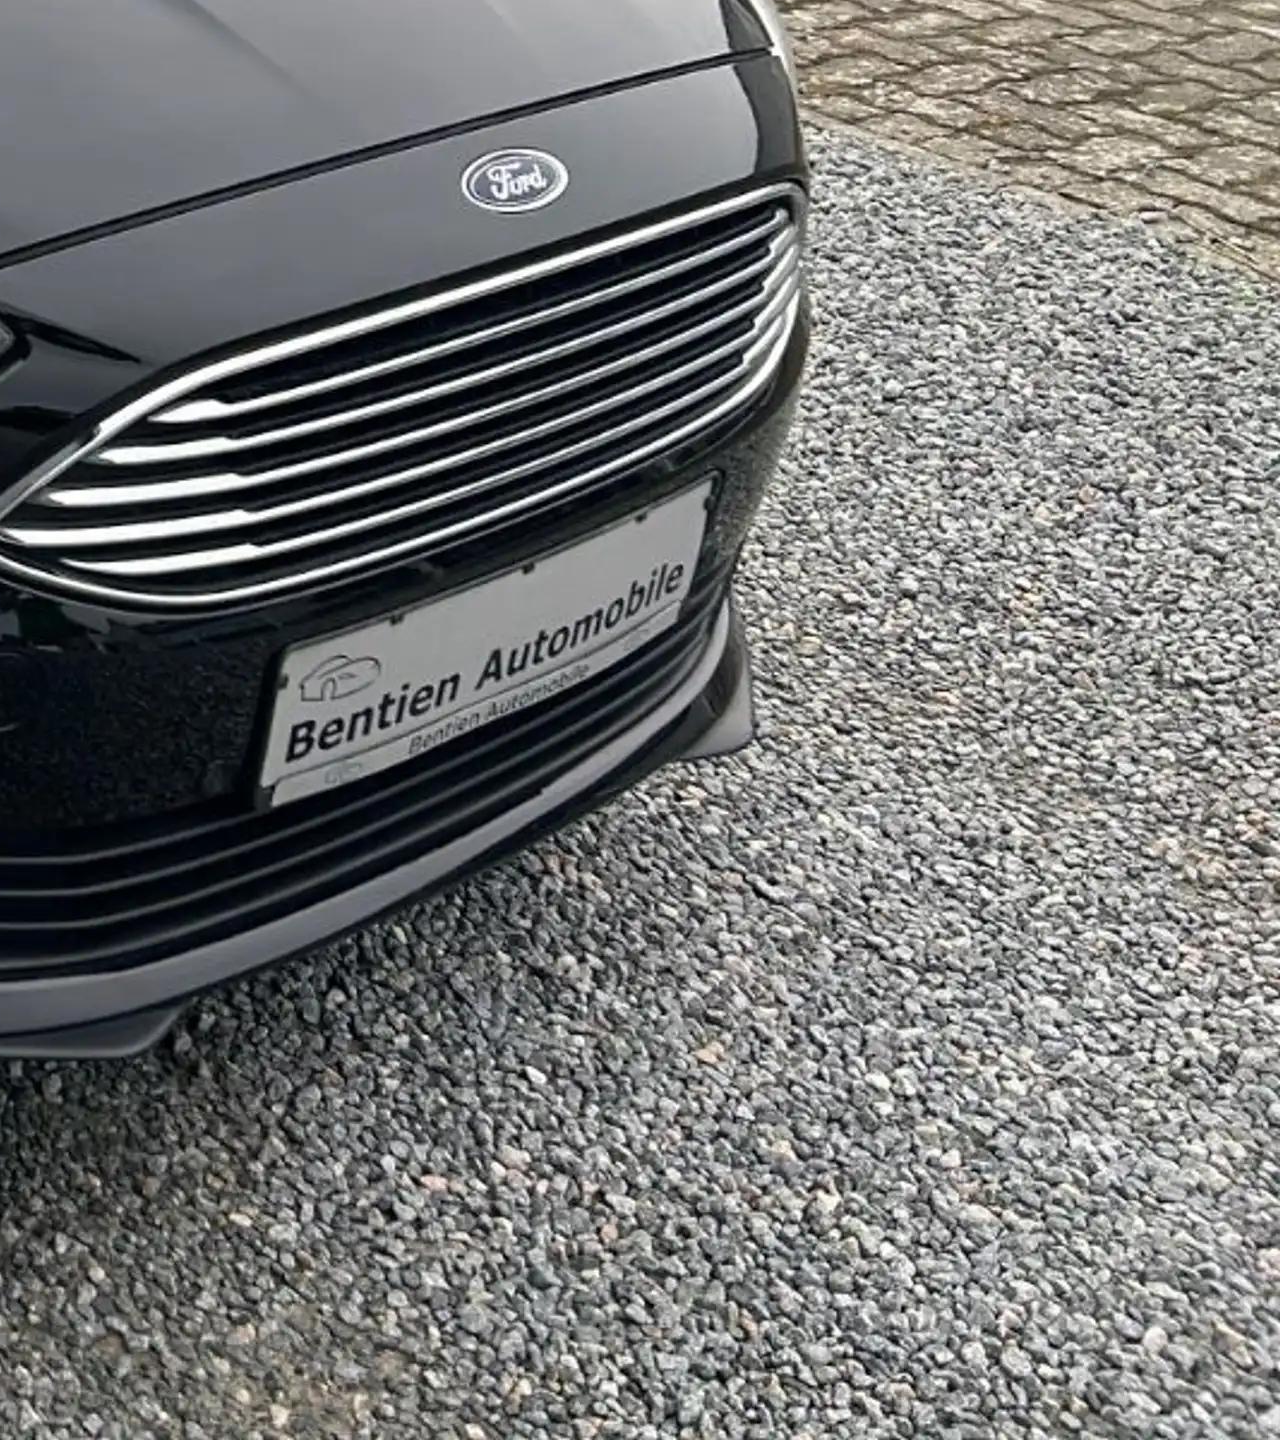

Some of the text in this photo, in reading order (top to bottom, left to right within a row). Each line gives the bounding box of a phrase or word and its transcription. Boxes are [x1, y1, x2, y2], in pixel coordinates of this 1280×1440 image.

[486, 161, 548, 200] Ford
[285, 562, 685, 764] Bentien Automobile
